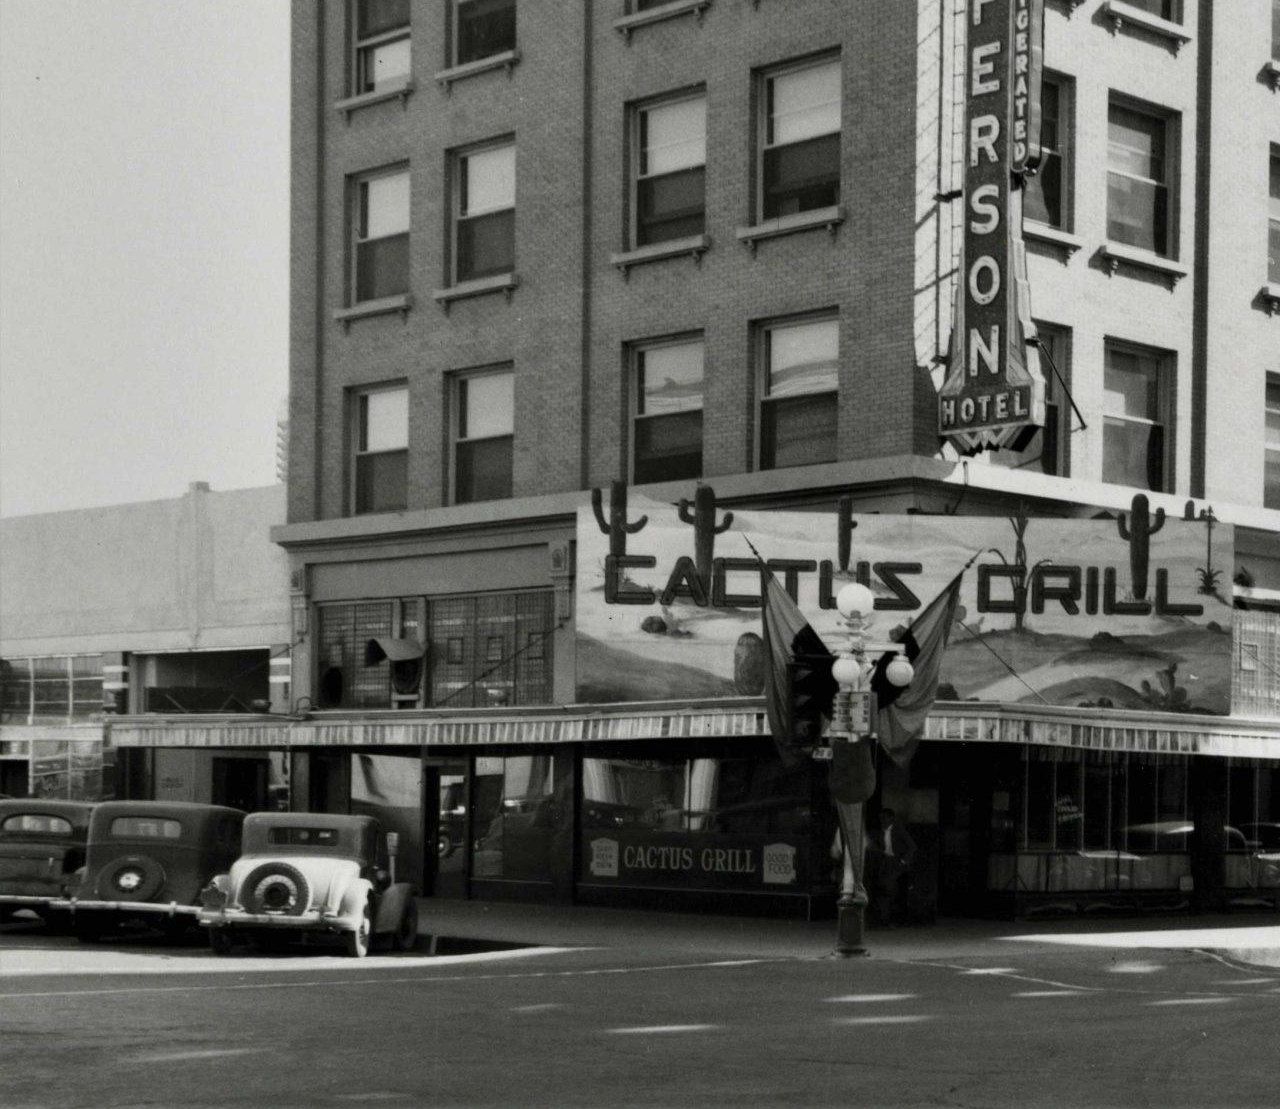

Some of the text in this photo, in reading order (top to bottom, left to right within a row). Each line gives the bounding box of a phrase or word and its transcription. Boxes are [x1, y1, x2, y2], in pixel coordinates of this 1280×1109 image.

[942, 390, 1029, 426] HOTEL
[605, 554, 1204, 616] CACTUS GRILL
[623, 845, 693, 871] CACTUS
[701, 848, 756, 872] GRILL
[766, 852, 789, 863] GOOD
[768, 863, 792, 875] FOOD
